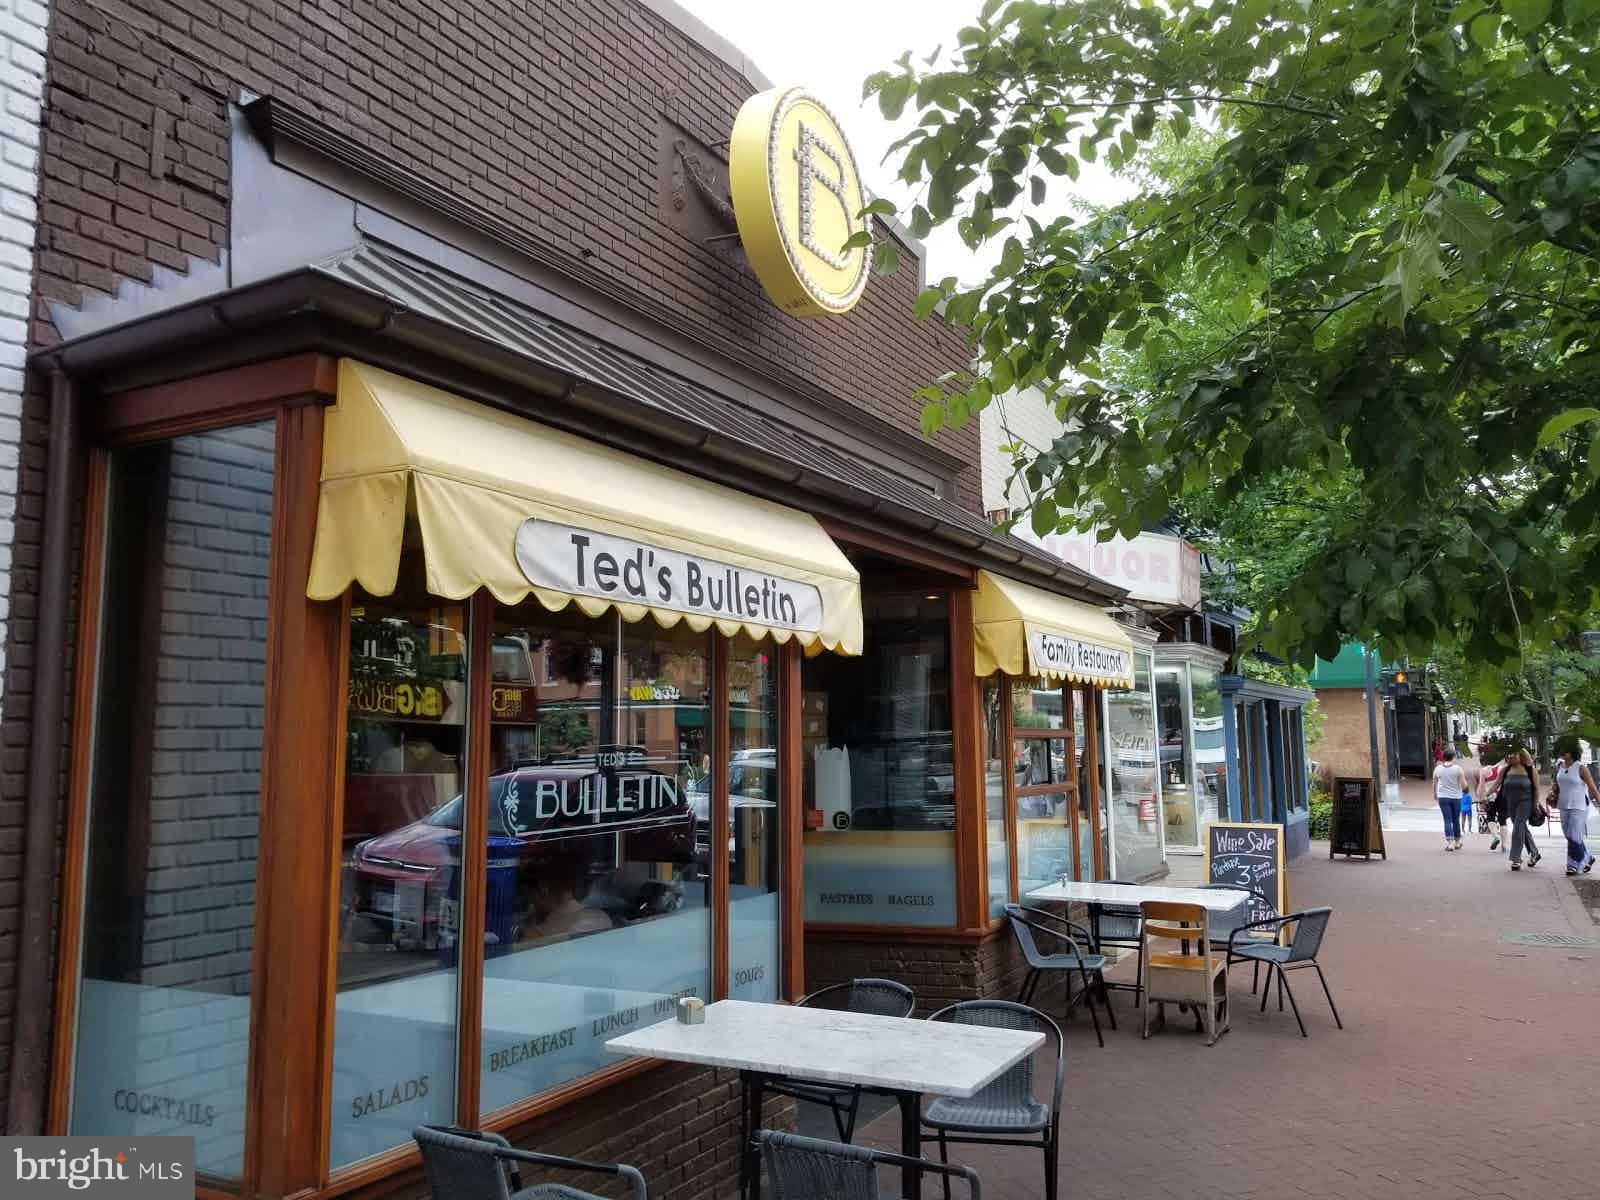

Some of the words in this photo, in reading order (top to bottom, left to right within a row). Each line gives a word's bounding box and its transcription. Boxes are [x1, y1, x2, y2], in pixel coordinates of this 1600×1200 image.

[570, 533, 673, 602] Ted's
[686, 560, 797, 624] Bulletin
[1042, 634, 1075, 668] Family
[598, 752, 626, 767] TED'S
[535, 774, 678, 819] BULLETIN
[1215, 830, 1245, 853] Wine
[1245, 831, 1276, 853] Sale
[1235, 865, 1251, 885] 3
[819, 893, 873, 905] PASTRIES
[735, 965, 765, 988] SOUPS
[489, 1027, 577, 1073] BREAKFAST
[592, 1007, 640, 1037] LUNCH
[113, 1089, 215, 1127] COCKTAILS
[351, 1075, 430, 1119] SALADS
